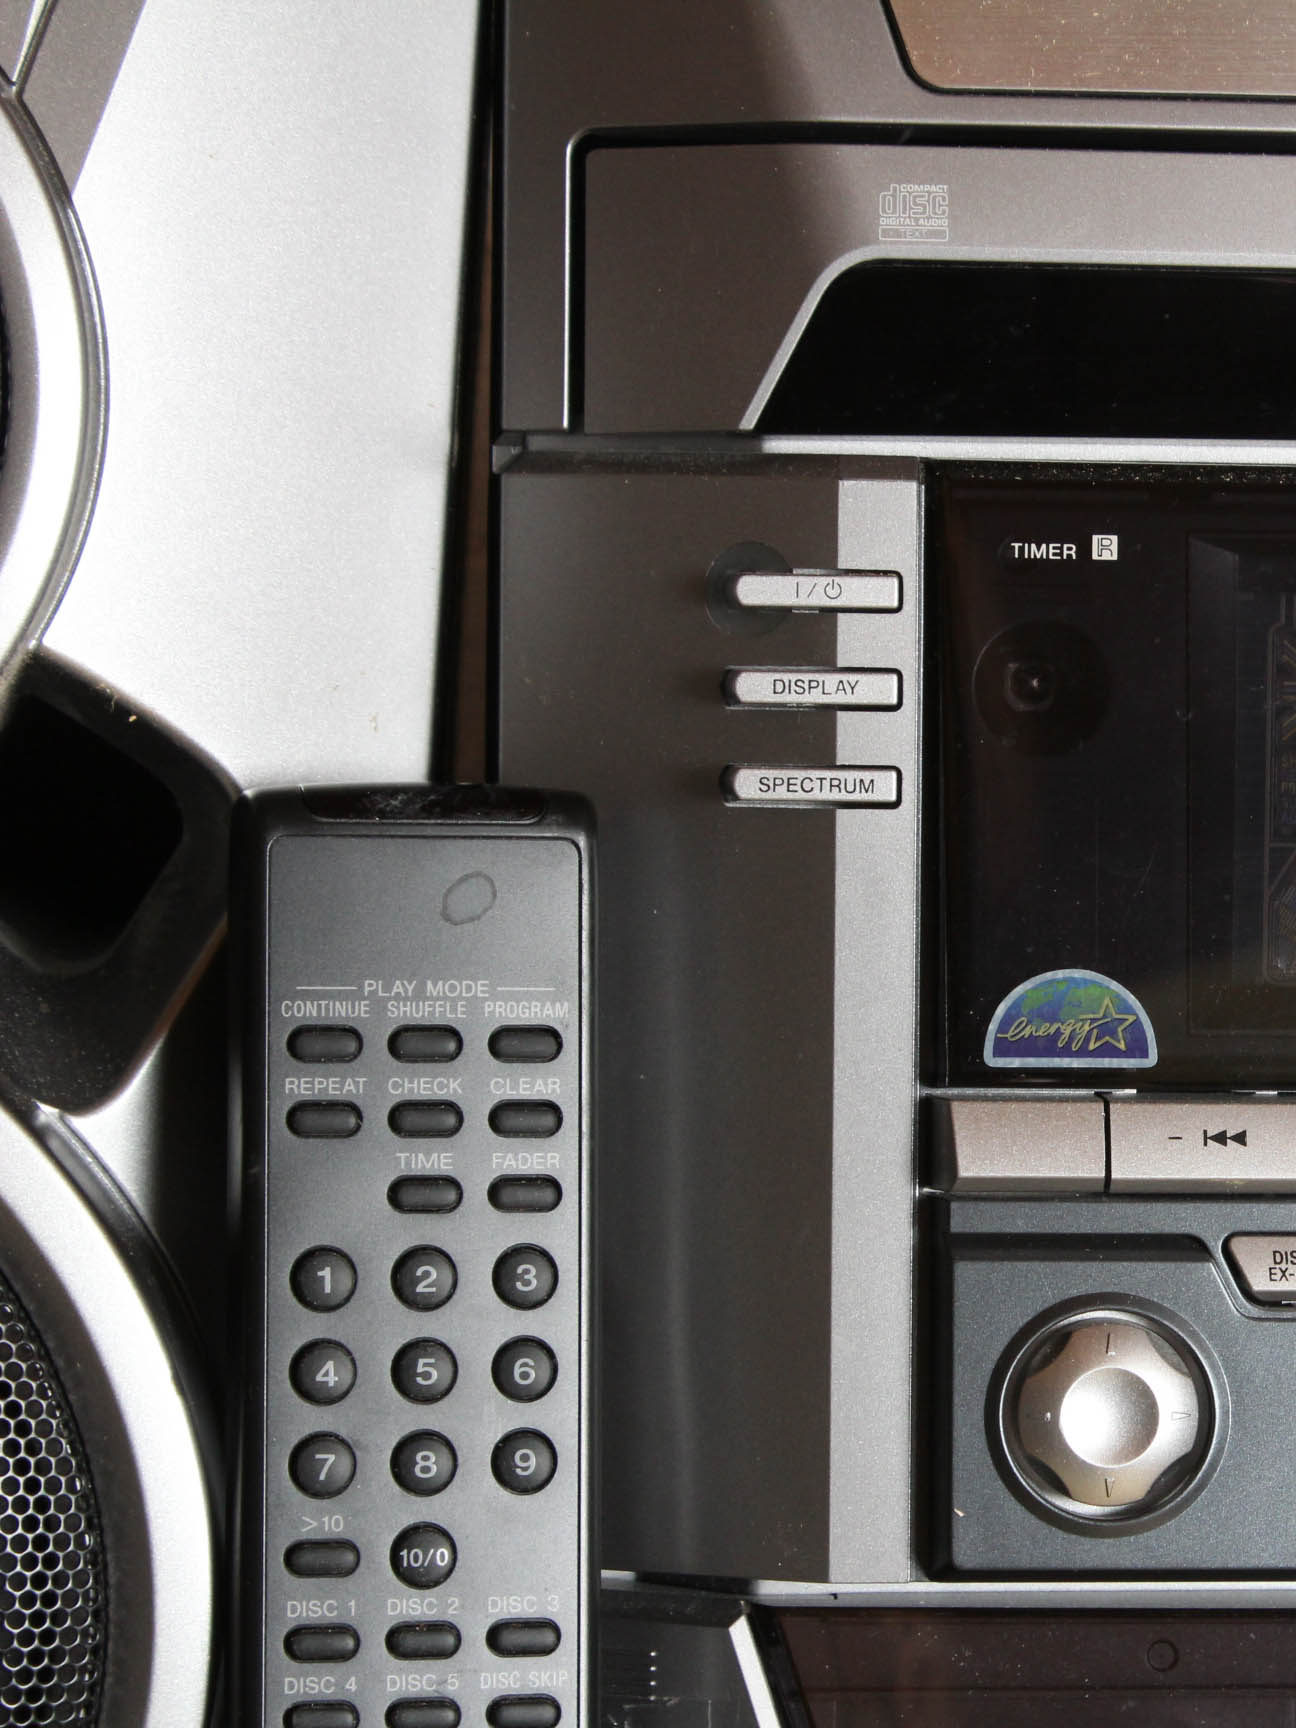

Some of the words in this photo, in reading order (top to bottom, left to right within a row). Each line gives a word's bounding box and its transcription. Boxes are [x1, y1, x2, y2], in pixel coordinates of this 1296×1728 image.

[900, 184, 948, 193] COMPACT
[880, 217, 915, 226] DIGITAL
[918, 218, 949, 226] AUDIO
[1011, 542, 1077, 560] TIMER
[773, 679, 860, 696] DISPLAY
[758, 776, 875, 795] SPECTRUM
[364, 980, 417, 997] PLAY
[426, 981, 490, 997] MODE
[281, 1000, 371, 1018] CONTINUE
[387, 1001, 467, 1018] SHUFFLE
[484, 1001, 569, 1018] PROGRAM
[999, 1016, 1096, 1051] energy
[285, 1078, 368, 1094] REPEAT
[388, 1078, 463, 1094] CHECK
[490, 1078, 561, 1094] CLEAR
[396, 1153, 453, 1169] TIME
[492, 1152, 560, 1169] FADER
[317, 1267, 331, 1294] 1
[415, 1266, 438, 1293] 2
[515, 1264, 538, 1292] 3
[315, 1360, 338, 1387] 4
[415, 1358, 438, 1385] 5
[513, 1358, 536, 1385] 6
[314, 1454, 336, 1481] 7
[414, 1451, 438, 1479] 8
[513, 1448, 536, 1476] 9
[399, 1548, 449, 1568] 10/0
[287, 1600, 338, 1617] DISC
[348, 1600, 356, 1617] 1
[388, 1599, 438, 1616] DISC
[448, 1598, 459, 1615] 2
[487, 1596, 539, 1613] DISC
[548, 1595, 560, 1612] 3
[283, 1677, 336, 1694] DISC
[345, 1676, 358, 1693] 4
[386, 1674, 438, 1691] DISC
[448, 1674, 459, 1690] 5
[480, 1672, 520, 1690] DISC
[528, 1671, 568, 1688] SKIP
